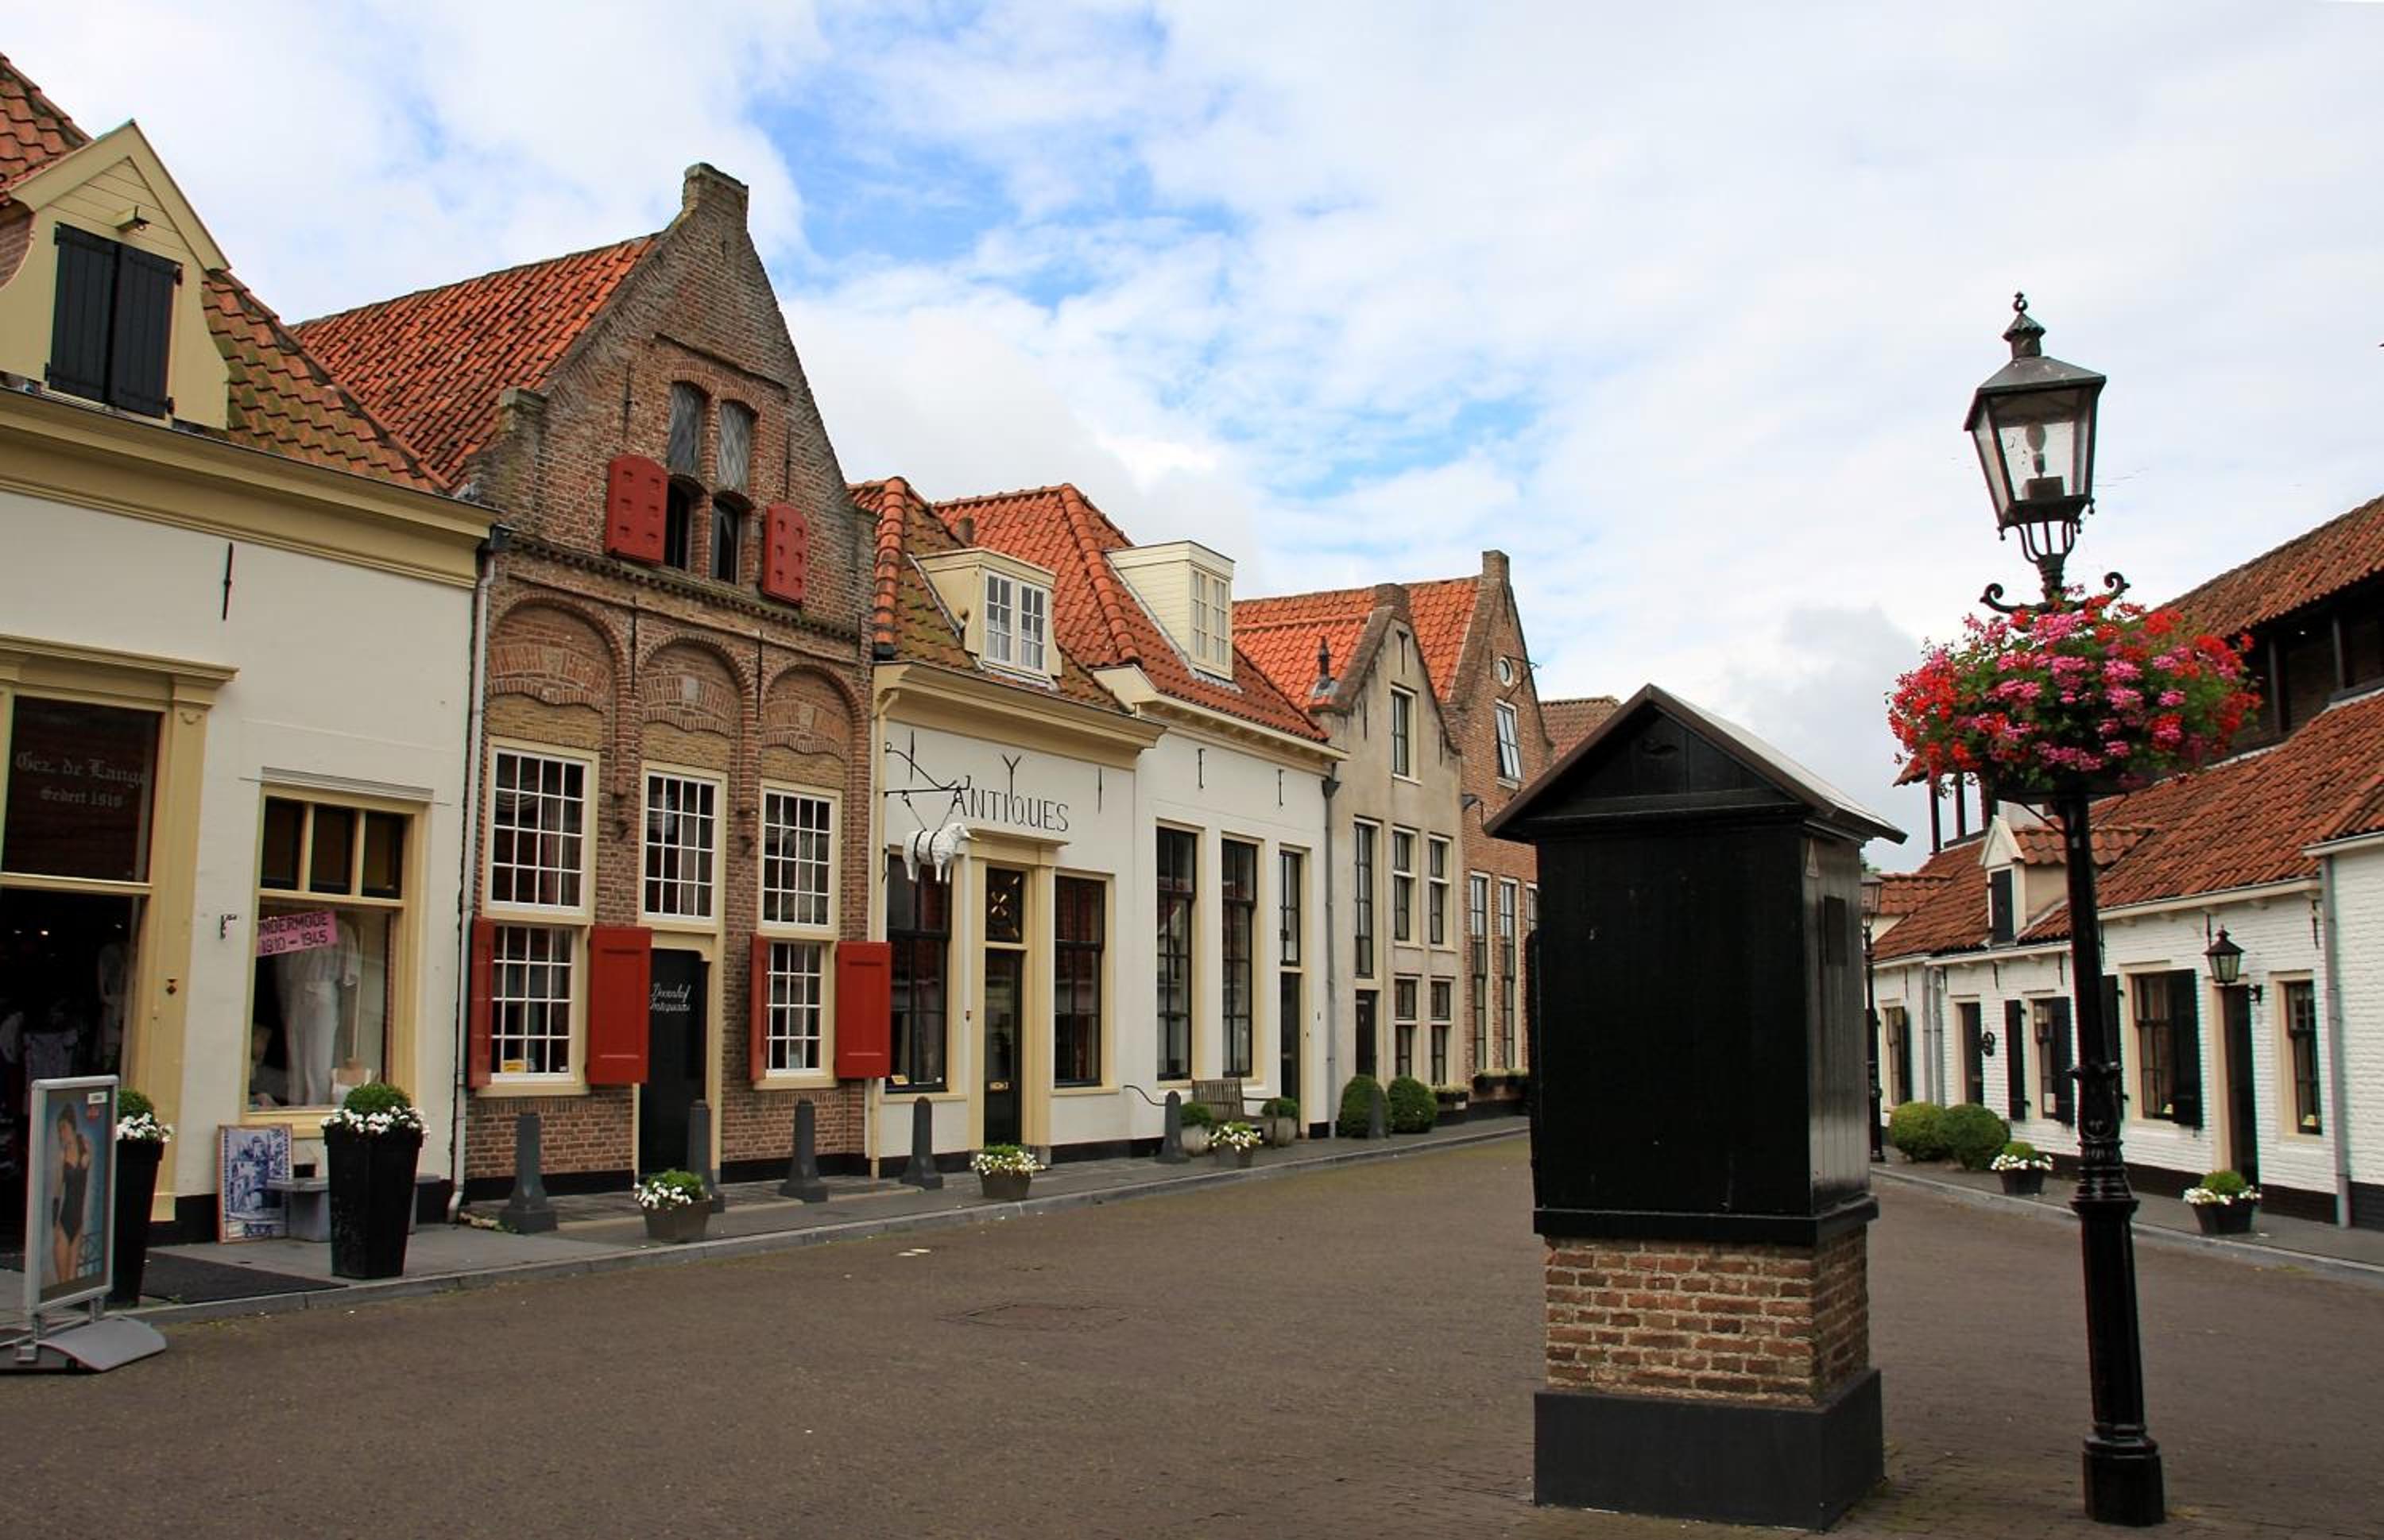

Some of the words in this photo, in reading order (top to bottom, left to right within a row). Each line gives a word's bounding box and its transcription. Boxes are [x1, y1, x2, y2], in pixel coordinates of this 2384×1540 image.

[63, 757, 84, 776] de
[950, 787, 1069, 832] ANTIQUES
[261, 937, 286, 954] 1910
[301, 930, 328, 946] 1945
